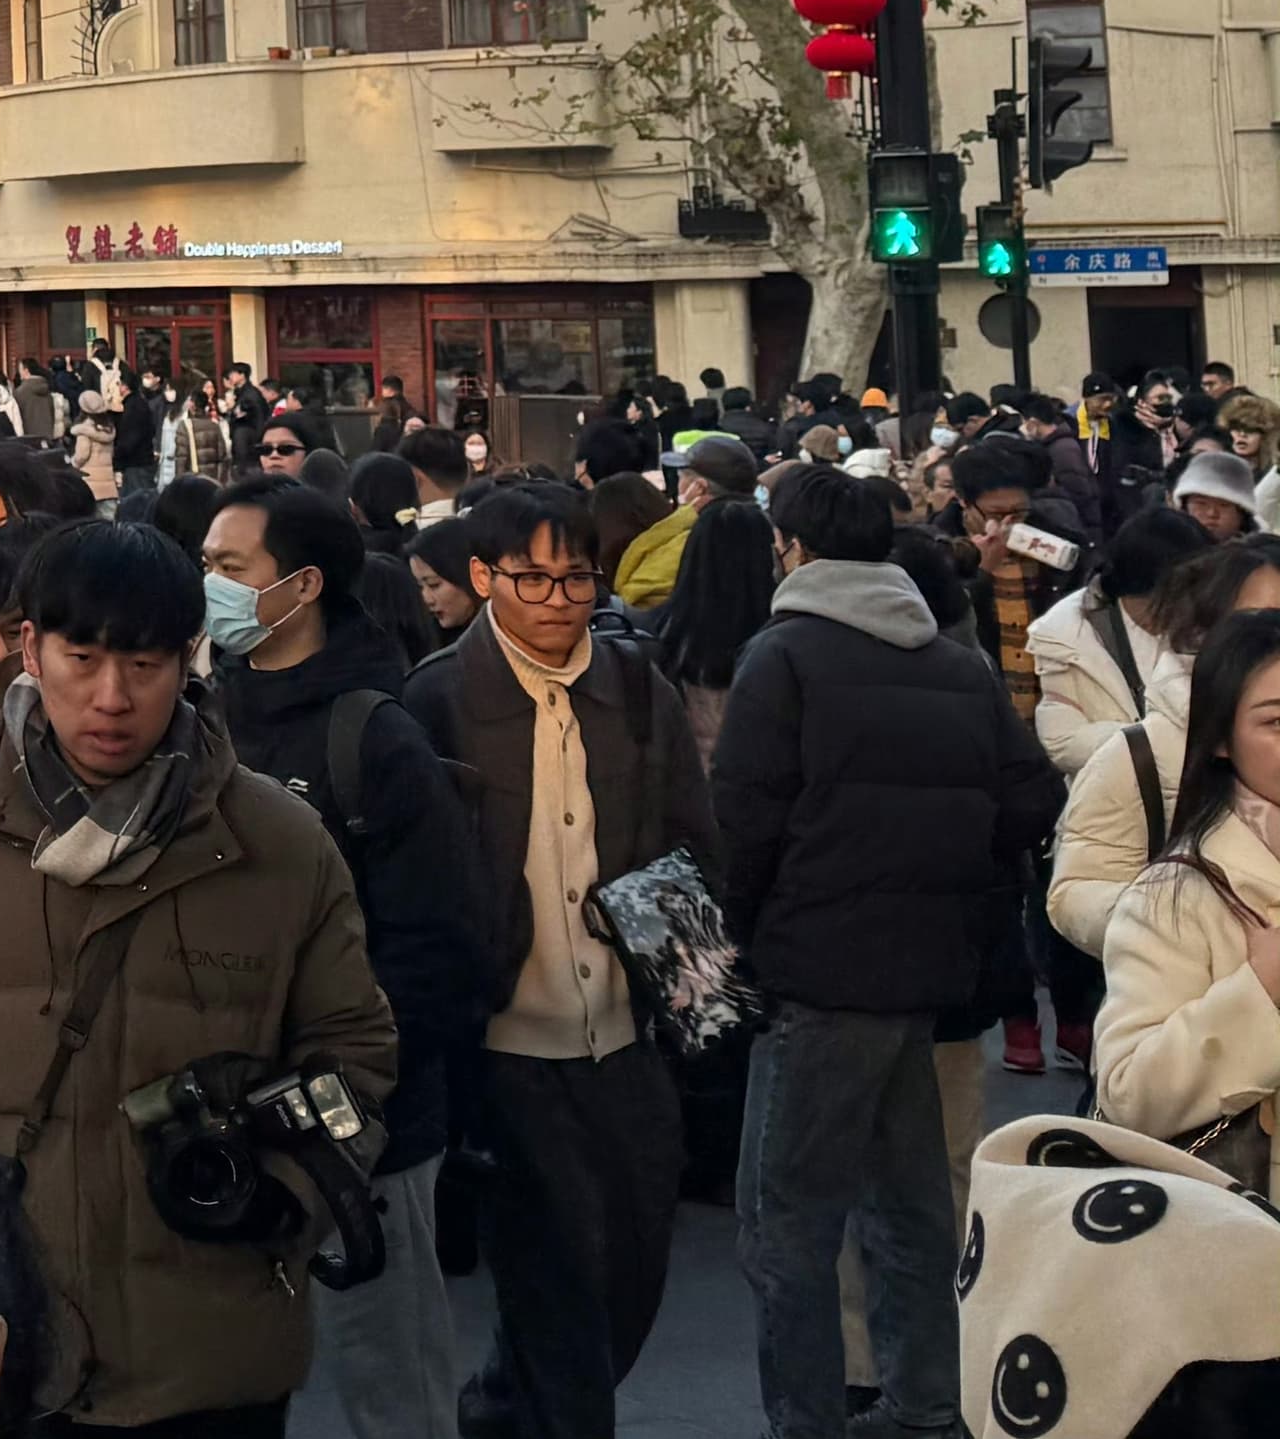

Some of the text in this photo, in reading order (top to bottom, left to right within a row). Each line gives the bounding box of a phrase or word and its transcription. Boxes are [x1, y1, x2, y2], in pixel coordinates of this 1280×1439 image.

[184, 240, 343, 258] Double Happiness Dessert
[1064, 253, 1132, 270] 余庆路
